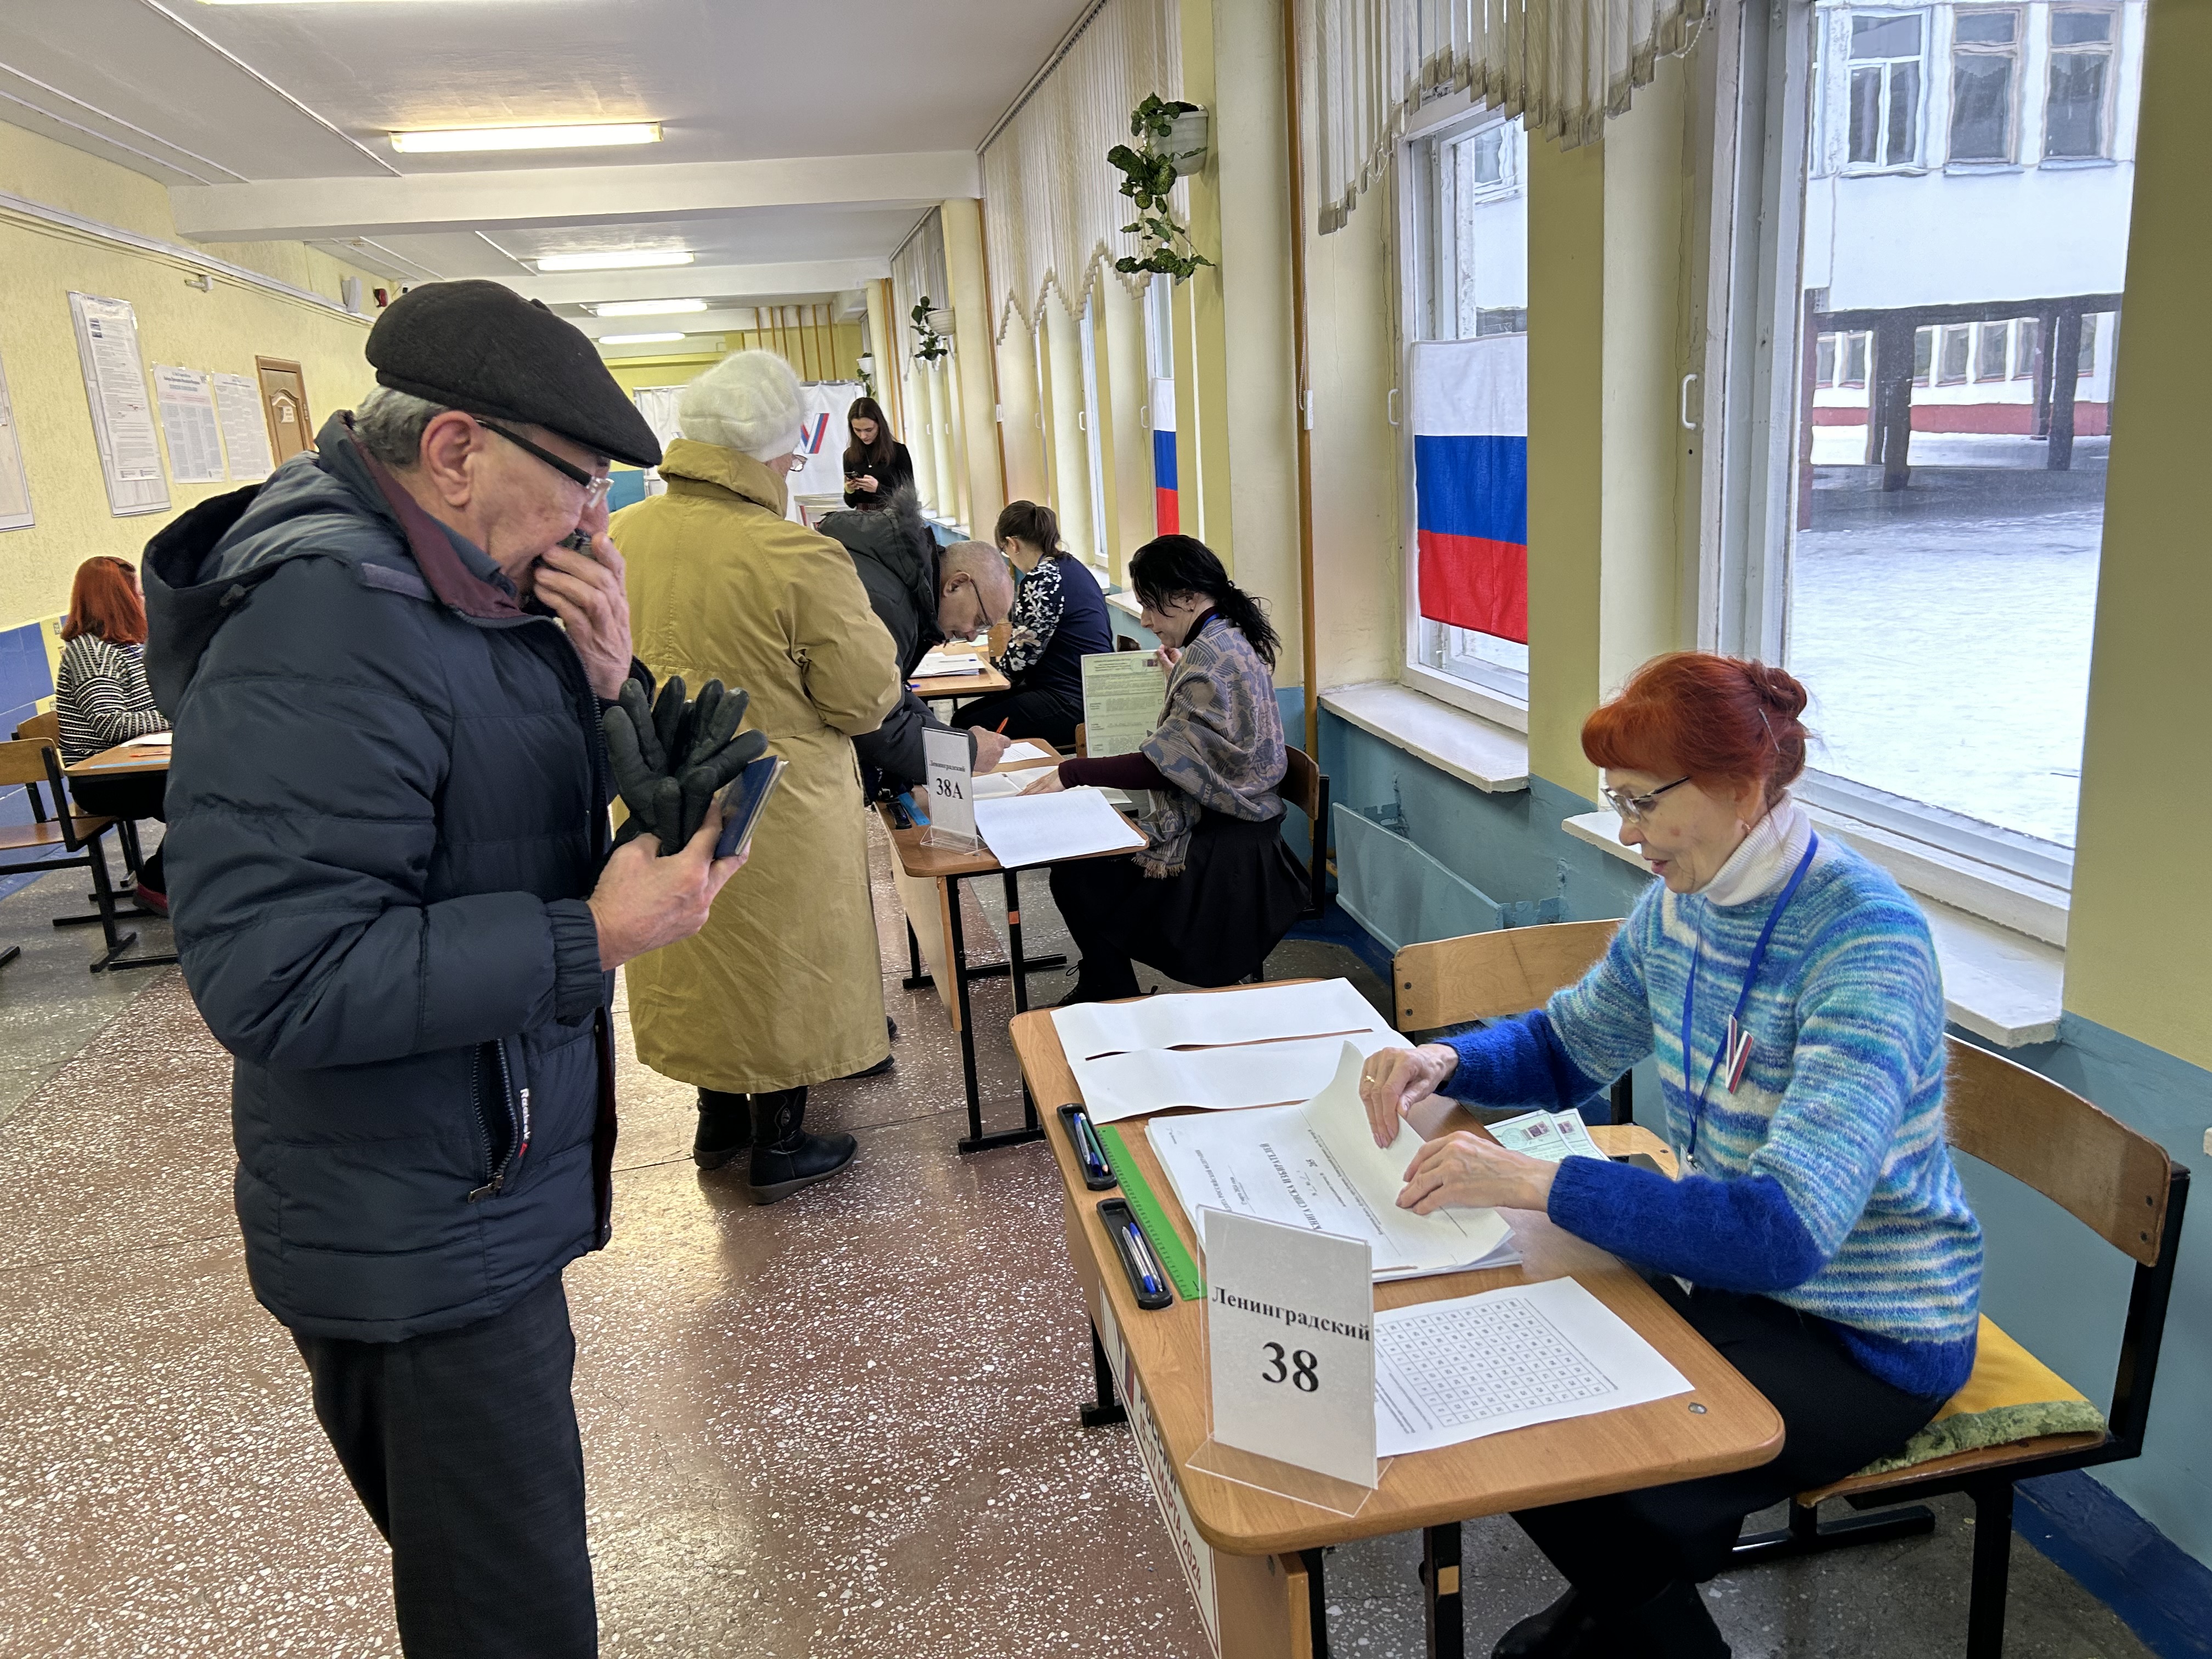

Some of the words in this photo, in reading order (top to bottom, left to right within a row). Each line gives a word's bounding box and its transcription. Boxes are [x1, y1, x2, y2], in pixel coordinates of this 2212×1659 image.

[936, 778, 963, 799] 38А
[1259, 1143, 1292, 1183] ИЗБИРАТЕЛЕЙ
[1287, 1184, 1308, 1209] СПИСКА
[1302, 1208, 1322, 1230] КНИГА
[1212, 1286, 1370, 1341] Ленинградский
[1262, 1341, 1319, 1392] 38
[1158, 1470, 1181, 1538] МАРТА
[1182, 1530, 1202, 1590] 2024
